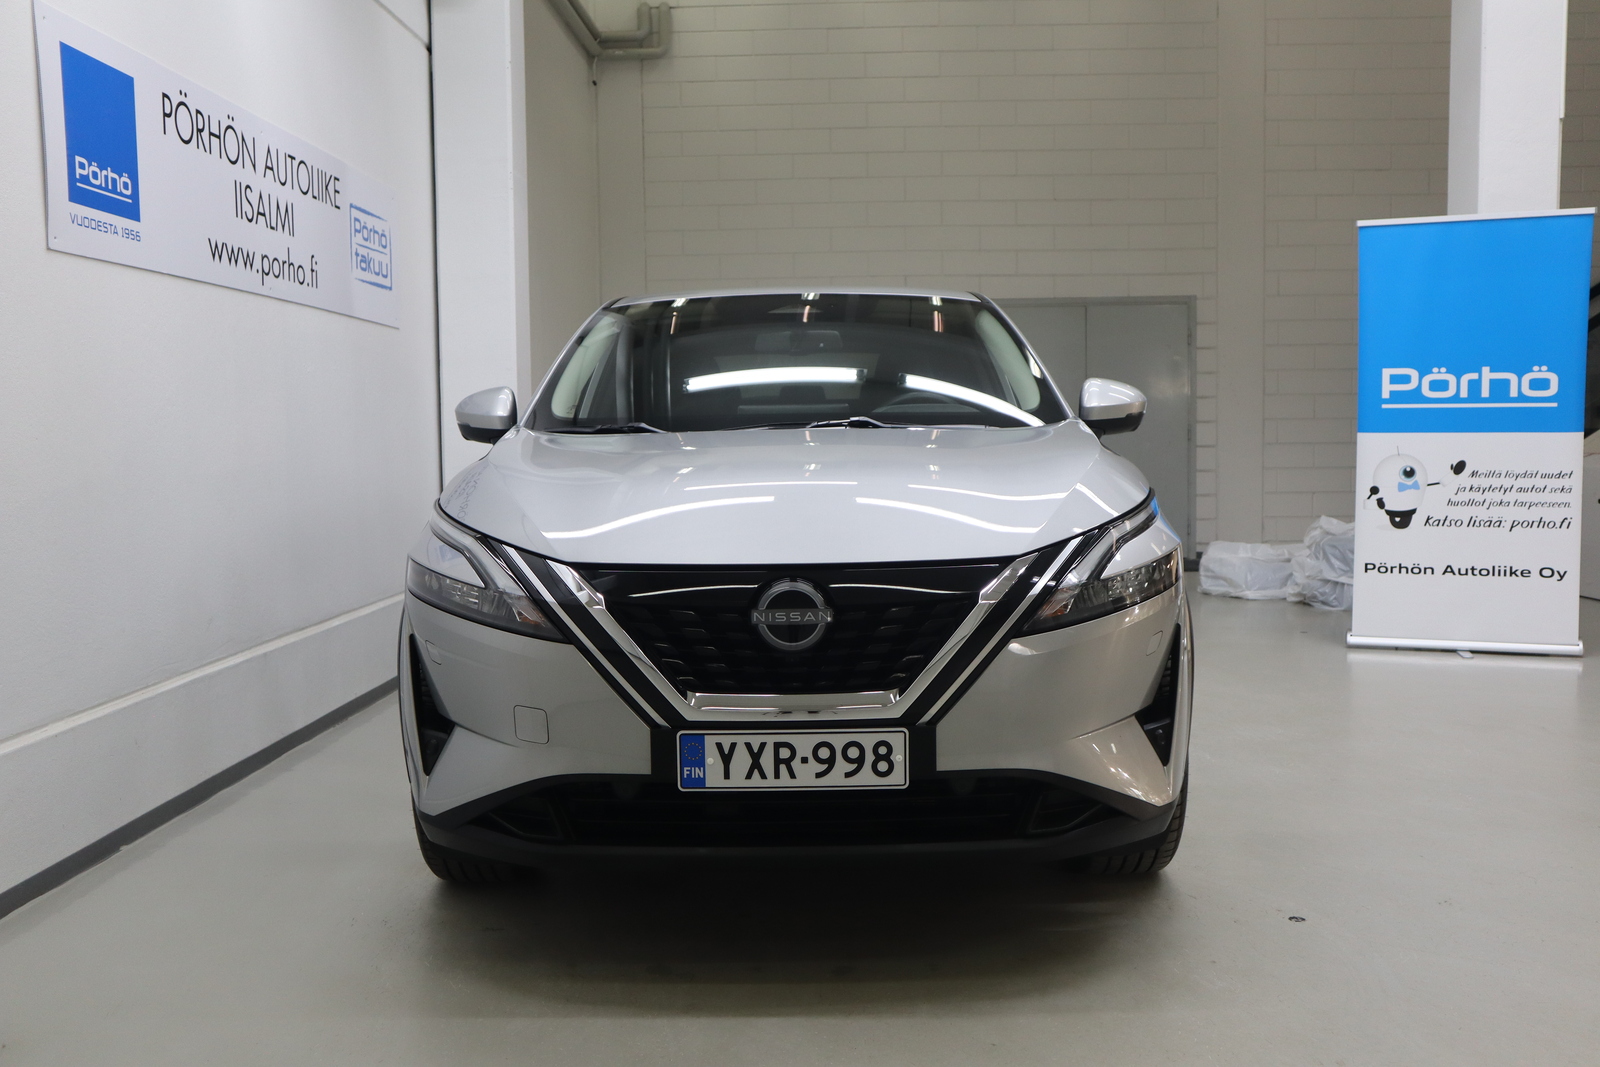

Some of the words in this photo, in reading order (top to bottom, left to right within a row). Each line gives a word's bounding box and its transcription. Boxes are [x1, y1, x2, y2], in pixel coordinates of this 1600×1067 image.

[162, 90, 257, 175] PÖRHÖN
[263, 143, 341, 210] AUTOLIIKE
[75, 155, 132, 196] Pörhö
[234, 179, 295, 237] IISALMI
[69, 212, 119, 237] VUODESTA
[121, 226, 142, 243] 1956
[353, 216, 388, 250] Pörhö
[207, 237, 318, 289] www.porho.fi
[354, 247, 389, 279] takuu
[1381, 365, 1559, 399] Pörhö
[1454, 484, 1467, 496] ja
[1468, 484, 1514, 495] käytetyt
[1515, 485, 1547, 494] autot
[1548, 485, 1573, 494] sekä
[1540, 470, 1574, 480] uudet
[1446, 498, 1486, 508] huollot
[1486, 498, 1511, 510] joka
[1512, 499, 1572, 510] tarpeeseen.
[1423, 515, 1464, 528] Katso
[1466, 515, 1507, 528] lisää:
[1508, 517, 1573, 532] porho.fi
[1364, 562, 1435, 575] Pörhön
[1441, 564, 1532, 578] Autoliike
[1538, 566, 1568, 581] Oy
[753, 610, 832, 623] NISSAN
[683, 766, 705, 779] FIN
[714, 740, 896, 780] YXR-998
